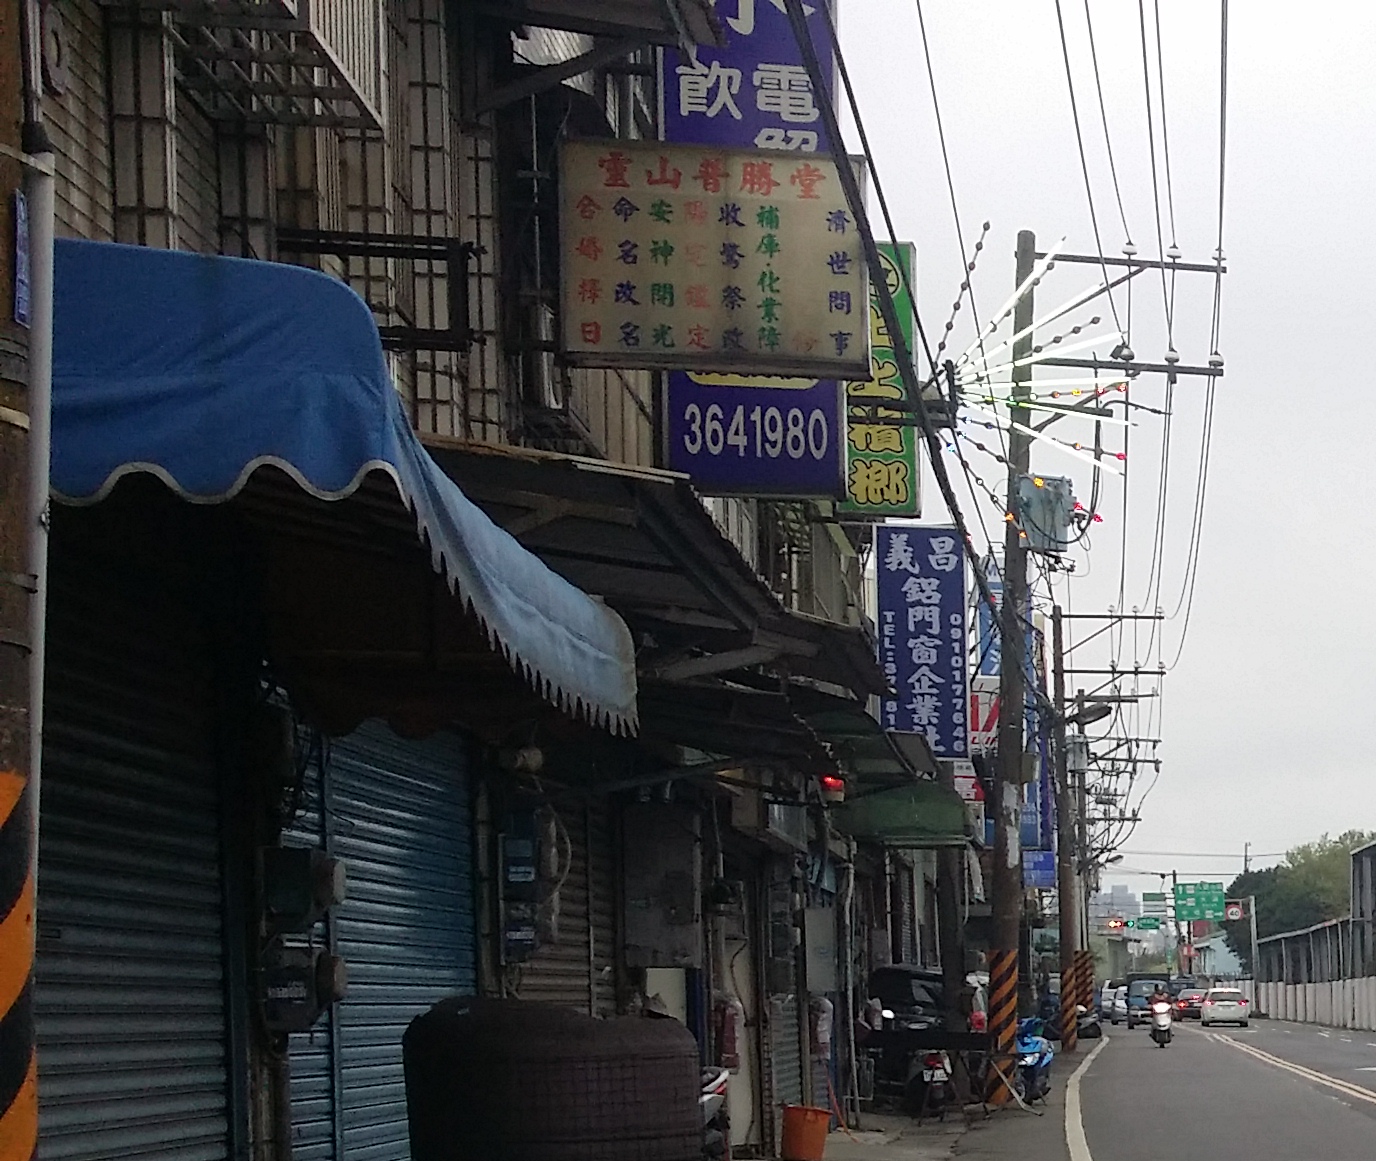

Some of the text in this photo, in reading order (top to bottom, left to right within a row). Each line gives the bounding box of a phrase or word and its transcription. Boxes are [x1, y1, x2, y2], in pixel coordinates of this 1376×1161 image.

[612, 196, 641, 347] 命名改名
[684, 403, 828, 460] 3641980
